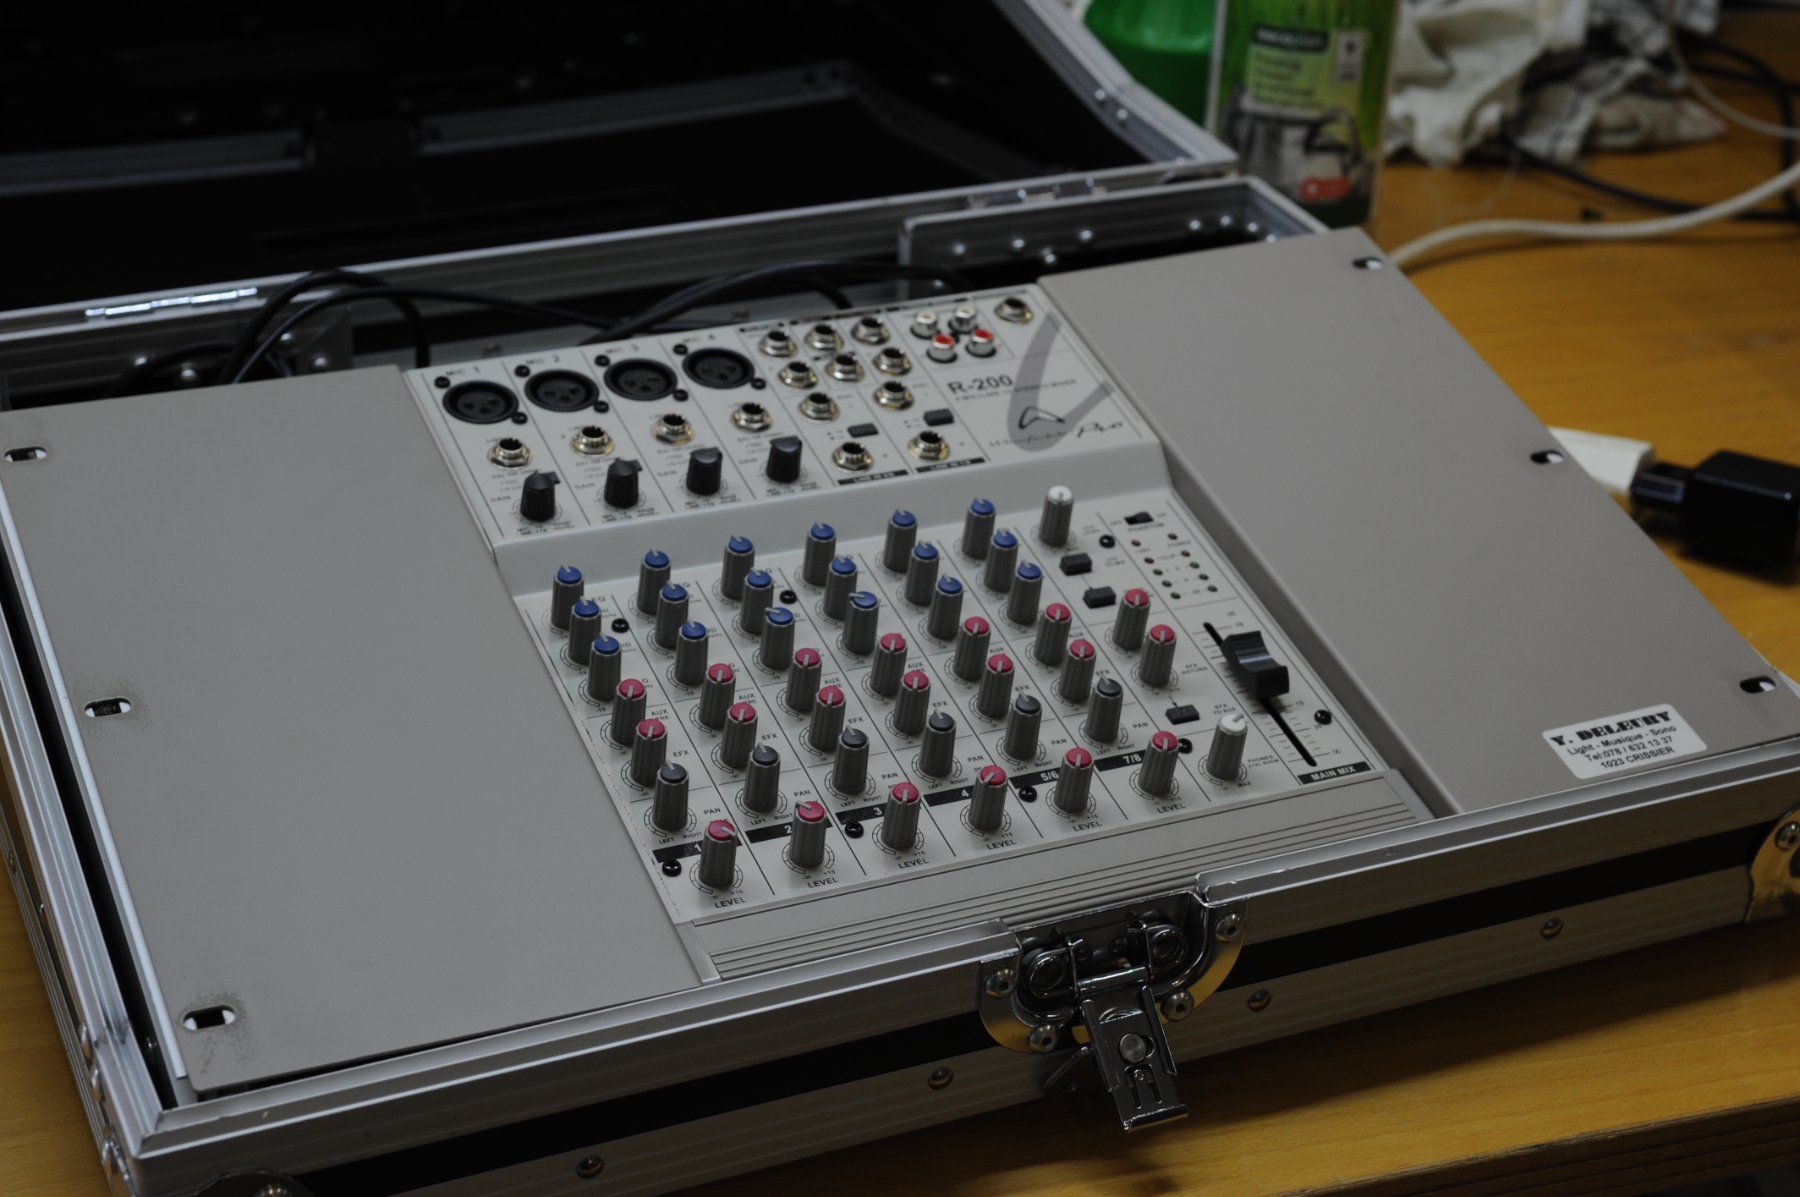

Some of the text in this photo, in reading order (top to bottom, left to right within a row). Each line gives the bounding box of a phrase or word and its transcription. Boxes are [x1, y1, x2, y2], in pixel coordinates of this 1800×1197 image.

[947, 373, 1014, 395] R-200
[1131, 721, 1149, 730] PAN
[761, 732, 780, 742] EFX
[1050, 738, 1067, 747] PAN
[1567, 745, 1594, 756] Light
[1601, 734, 1643, 747] Musique
[1650, 726, 1676, 737] Sono
[1649, 739, 1660, 748] 13
[1662, 736, 1673, 745] 37
[672, 748, 690, 759] EFX
[967, 754, 985, 763] PAN
[1600, 746, 1675, 769] 1023 CRISSIER
[1121, 754, 1143, 765] 7/8
[880, 771, 899, 781] PAN
[1039, 771, 1060, 782] 5/6
[1310, 765, 1357, 782] MAIN MIX
[793, 789, 812, 799] PAN
[702, 807, 722, 816] PAN
[873, 806, 884, 817] 3
[1156, 802, 1187, 815] LEVEL
[1072, 819, 1103, 833] LEVEL
[986, 838, 1018, 851] LEVEL
[898, 856, 931, 870] LEVEL
[807, 876, 840, 890] LEVEL
[714, 896, 747, 910] LEVEL
